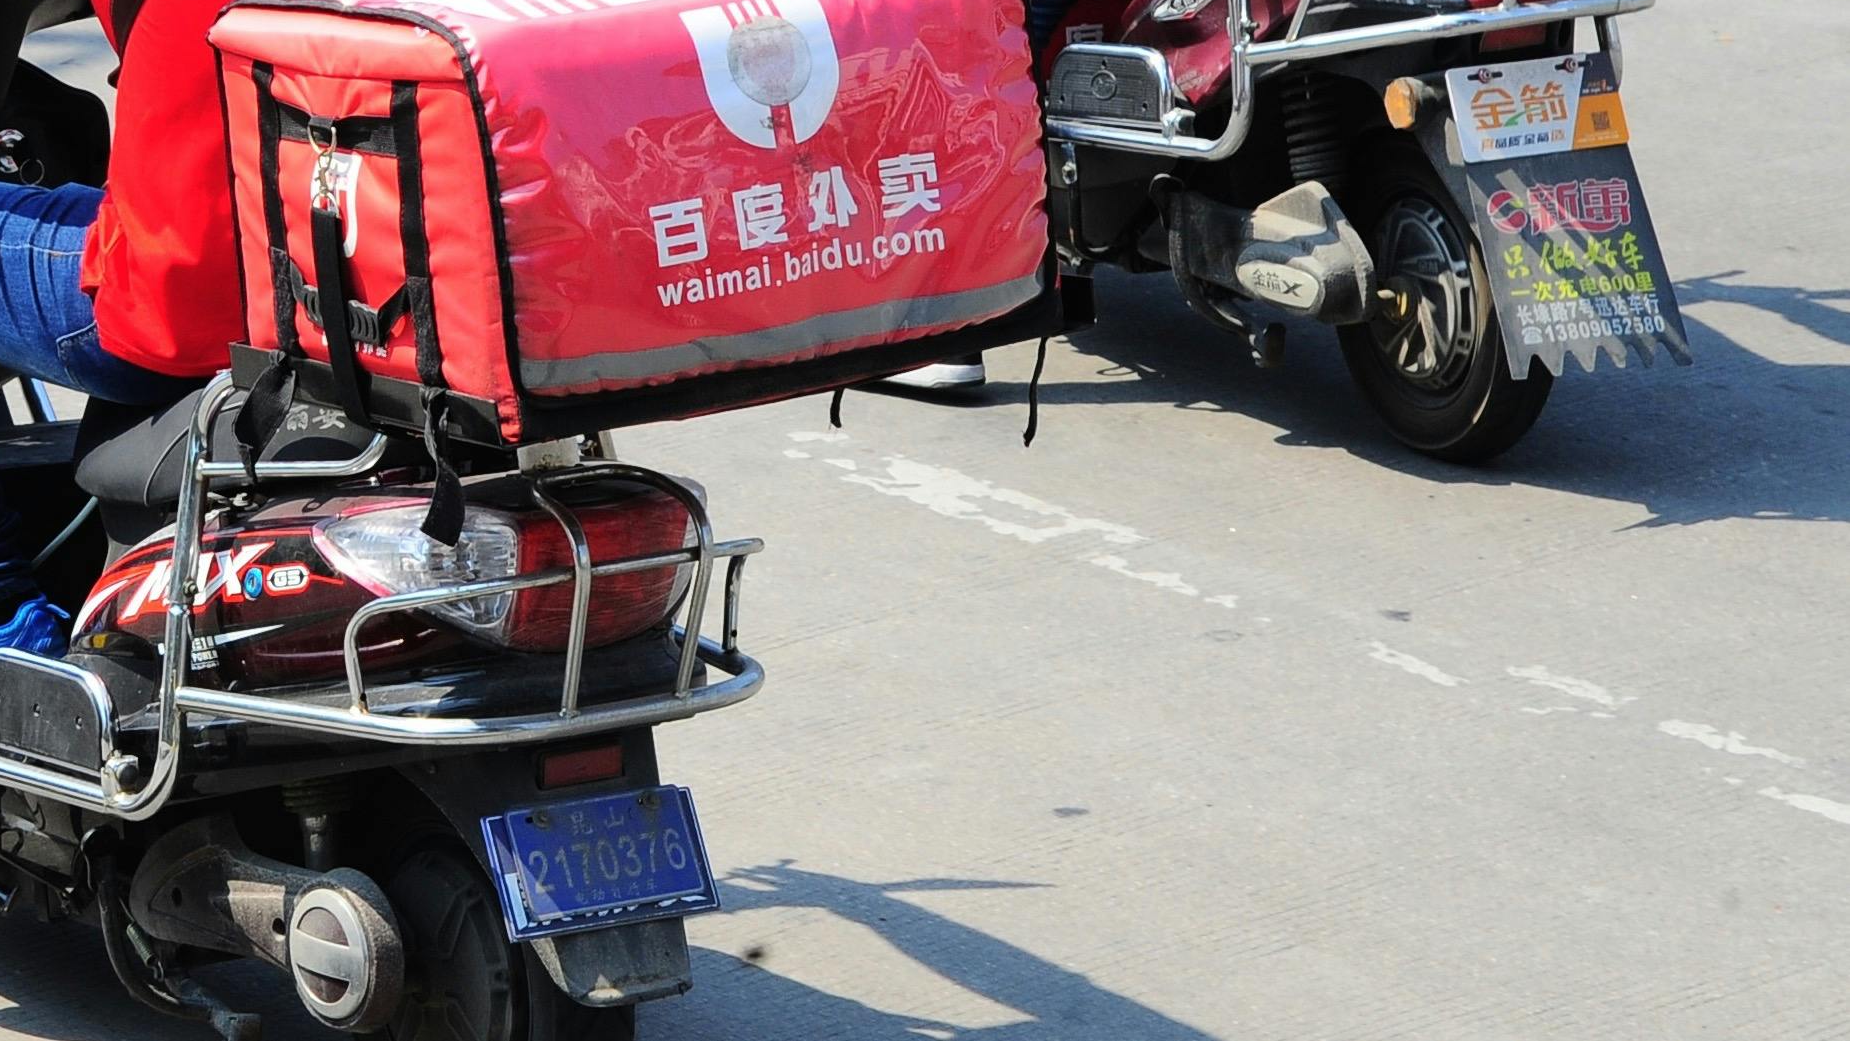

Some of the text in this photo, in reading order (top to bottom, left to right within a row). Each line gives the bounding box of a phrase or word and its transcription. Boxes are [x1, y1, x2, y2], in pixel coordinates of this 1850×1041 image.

[1470, 81, 1568, 131] 金箭
[649, 152, 941, 268] 百度外卖
[657, 227, 945, 307] waimai.baidu.com
[1511, 271, 1656, 301] 一次充电600里
[1544, 315, 1666, 342] 13809052580
[528, 828, 686, 894] 2170376
